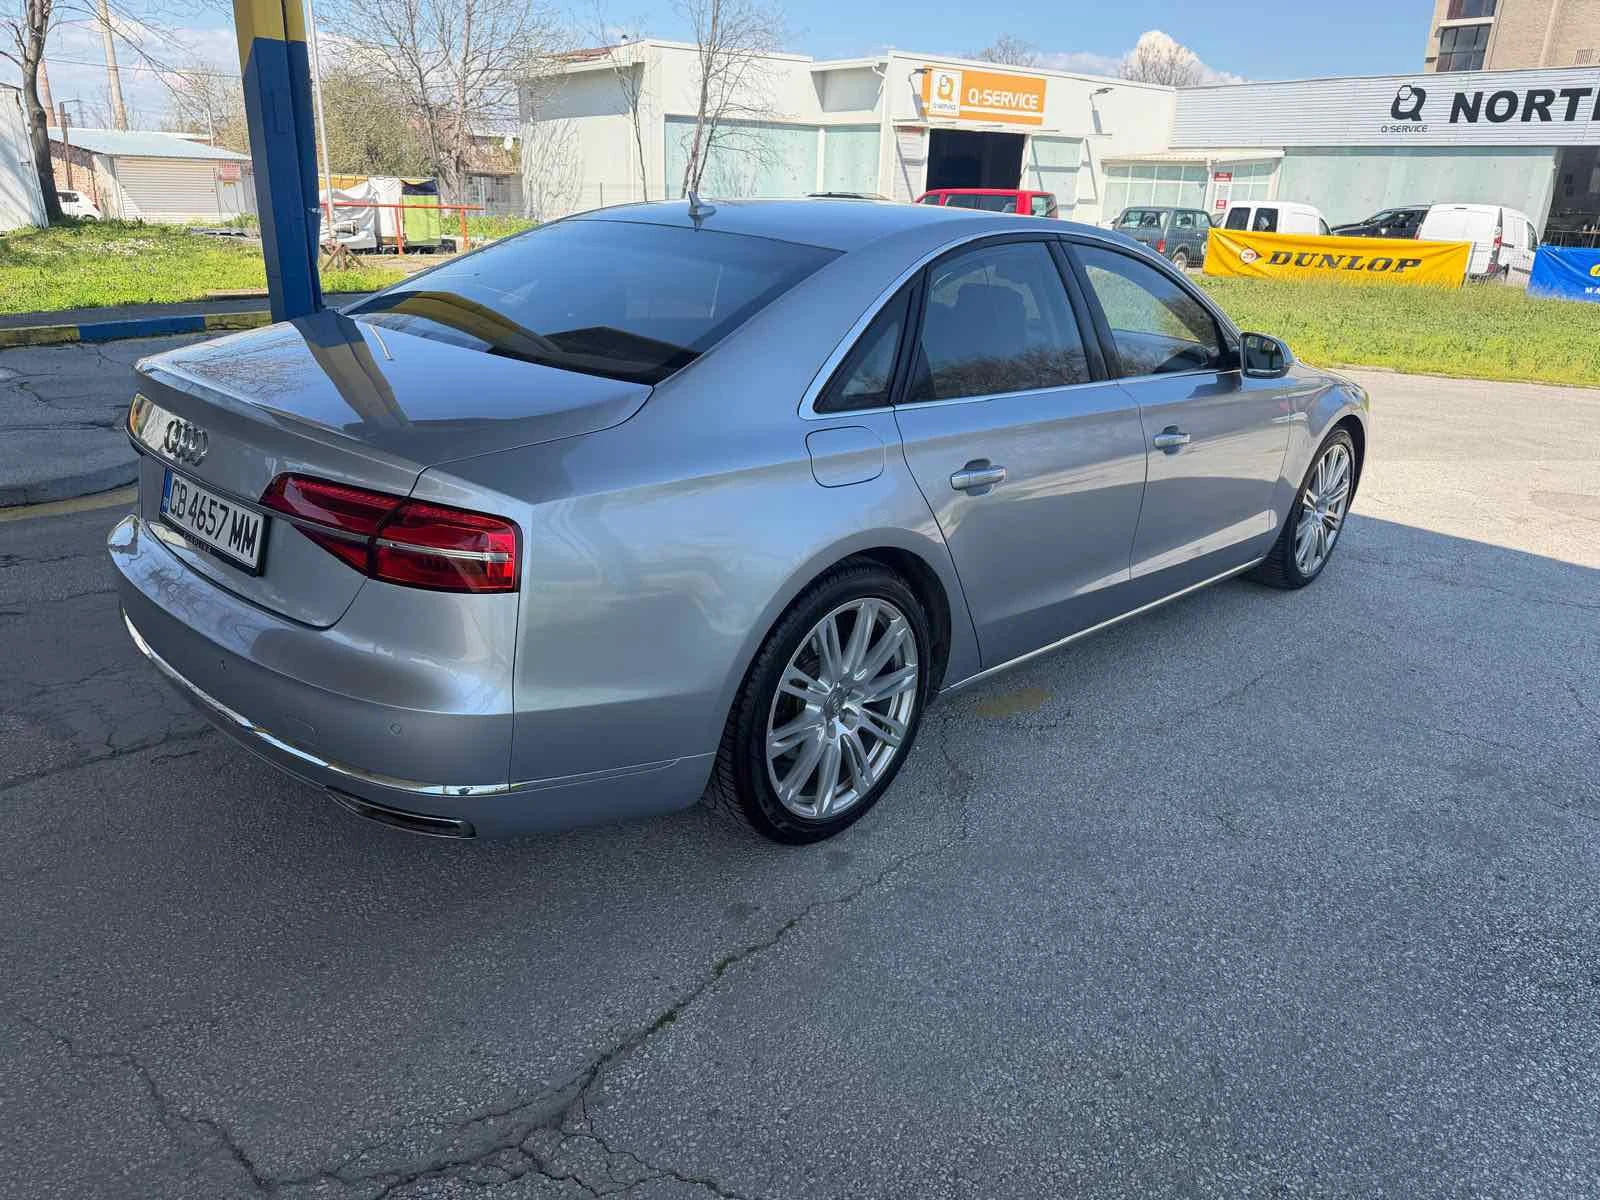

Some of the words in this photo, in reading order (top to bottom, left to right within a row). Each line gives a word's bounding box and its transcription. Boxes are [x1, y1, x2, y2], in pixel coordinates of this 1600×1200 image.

[1449, 87, 1600, 124] NORT
[1265, 251, 1423, 273] DUNLOP
[170, 478, 187, 519] CB
[188, 491, 230, 540] 4657
[228, 510, 259, 557] MM
